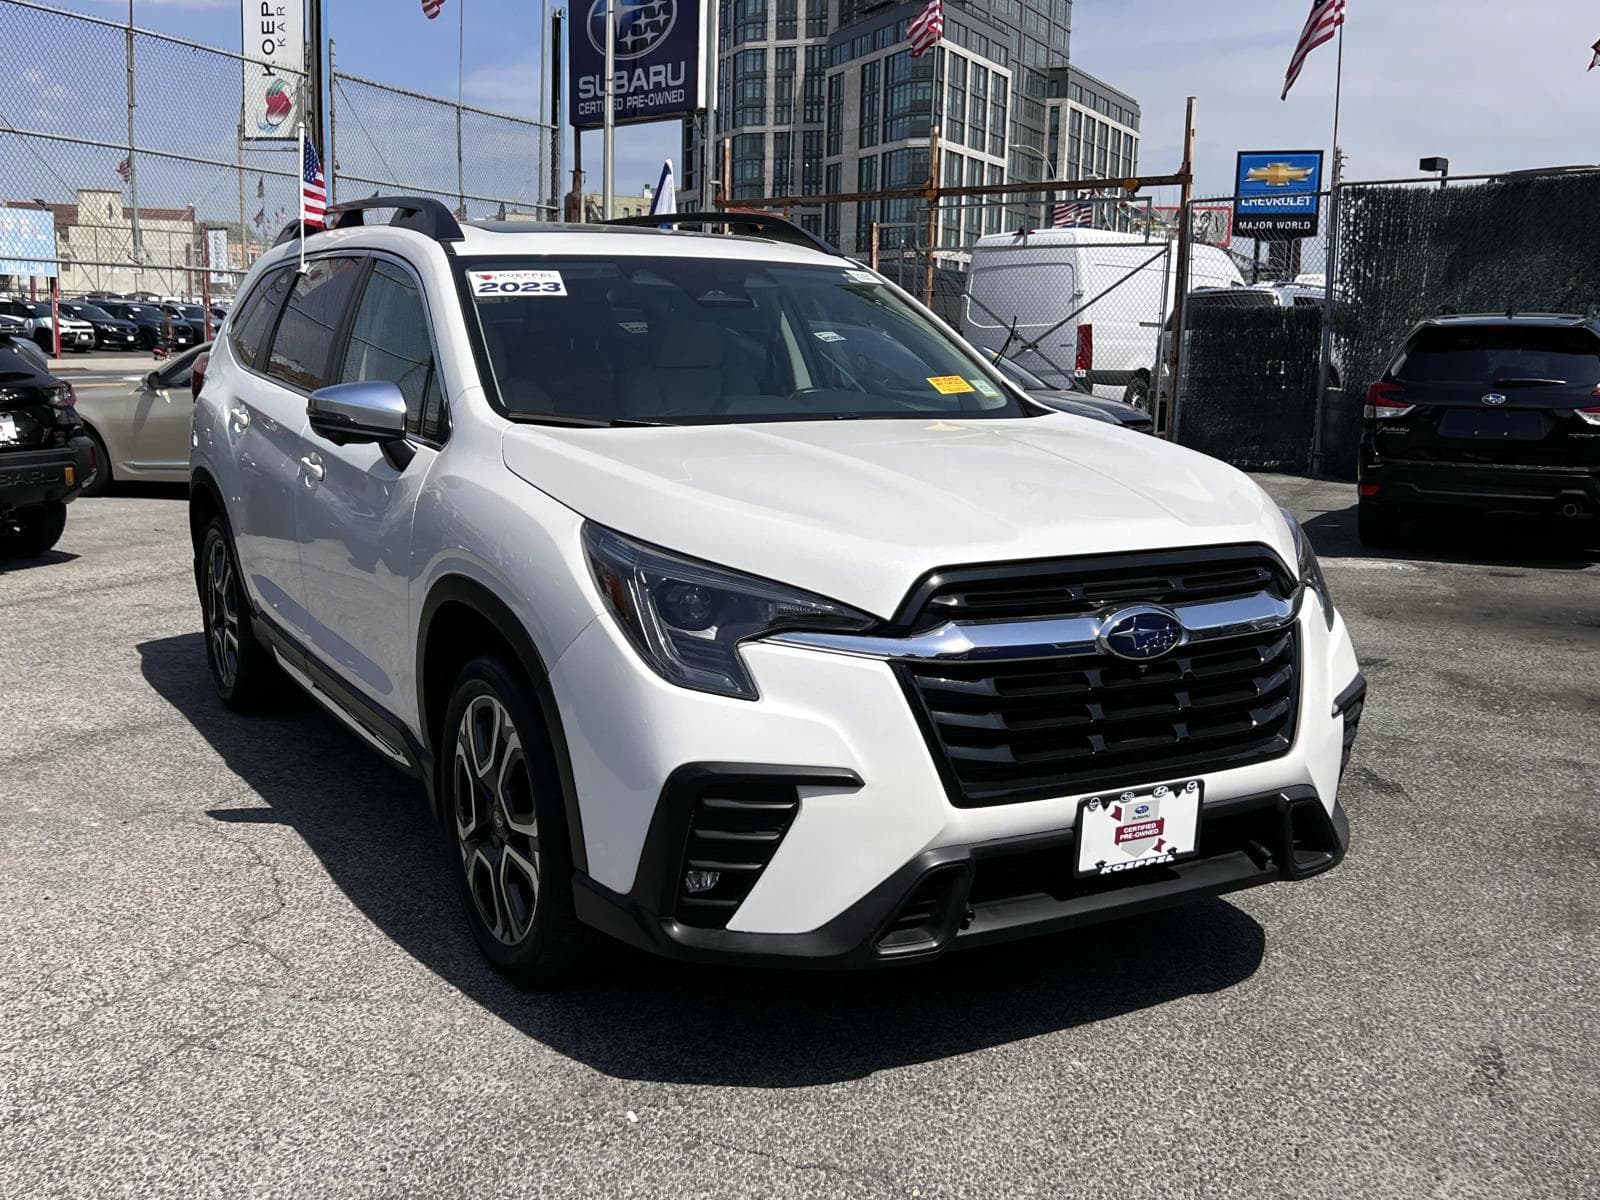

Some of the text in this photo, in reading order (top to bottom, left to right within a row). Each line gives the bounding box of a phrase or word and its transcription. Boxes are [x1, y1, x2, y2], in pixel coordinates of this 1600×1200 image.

[578, 61, 685, 99] SUBARU
[626, 89, 685, 109] PRE-OWNED
[1239, 221, 1311, 230] MAJOR WORLD
[478, 282, 561, 293] 2023
[1119, 828, 1160, 841] PRE-OWNED
[1123, 822, 1157, 834] CERTIFIED
[1100, 854, 1175, 875] KOEPPEL
